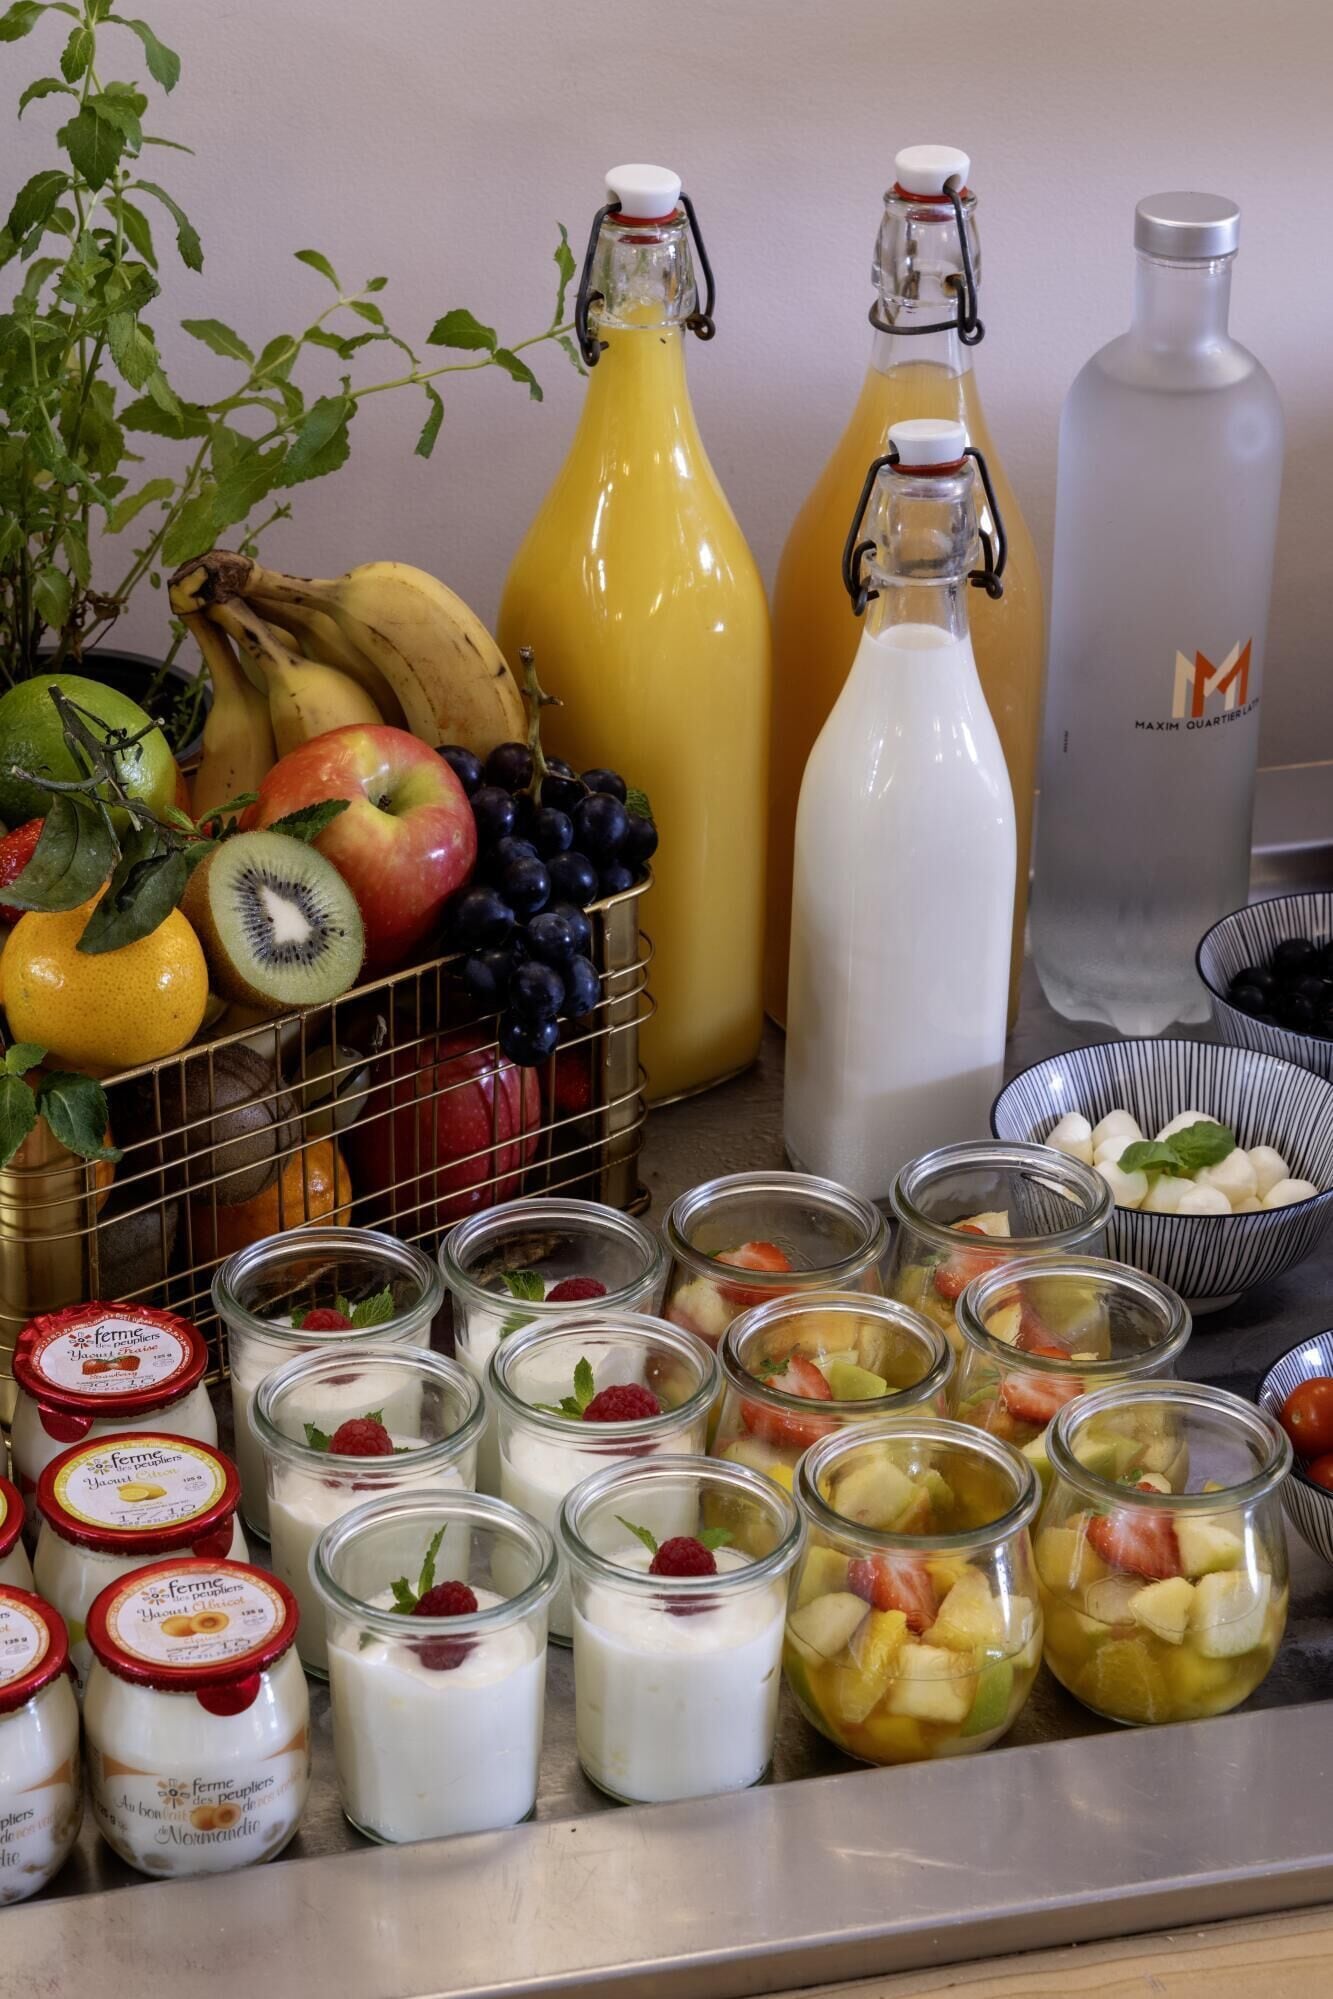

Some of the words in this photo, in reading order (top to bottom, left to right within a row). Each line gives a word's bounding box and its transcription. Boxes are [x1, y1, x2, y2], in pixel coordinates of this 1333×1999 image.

[1135, 720, 1179, 731] MAXIM
[1186, 709, 1242, 730] QUARTIER
[95, 1325, 144, 1345] ferme
[113, 1332, 161, 1348] peupliers
[67, 1350, 114, 1361] Yaourt
[111, 1450, 162, 1469] ferme
[134, 1454, 183, 1471] peupliers
[83, 1475, 133, 1490] Yaourt
[168, 1577, 224, 1598] ferme
[192, 1582, 245, 1601] peupliers
[137, 1606, 189, 1623] Yaourt
[192, 1777, 234, 1796] ferme
[192, 1796, 214, 1806] des
[218, 1776, 275, 1805] peupliers
[116, 1794, 135, 1812] Au
[139, 1801, 161, 1819] bon
[242, 1797, 257, 1813] de
[155, 1817, 262, 1846] Normandie
